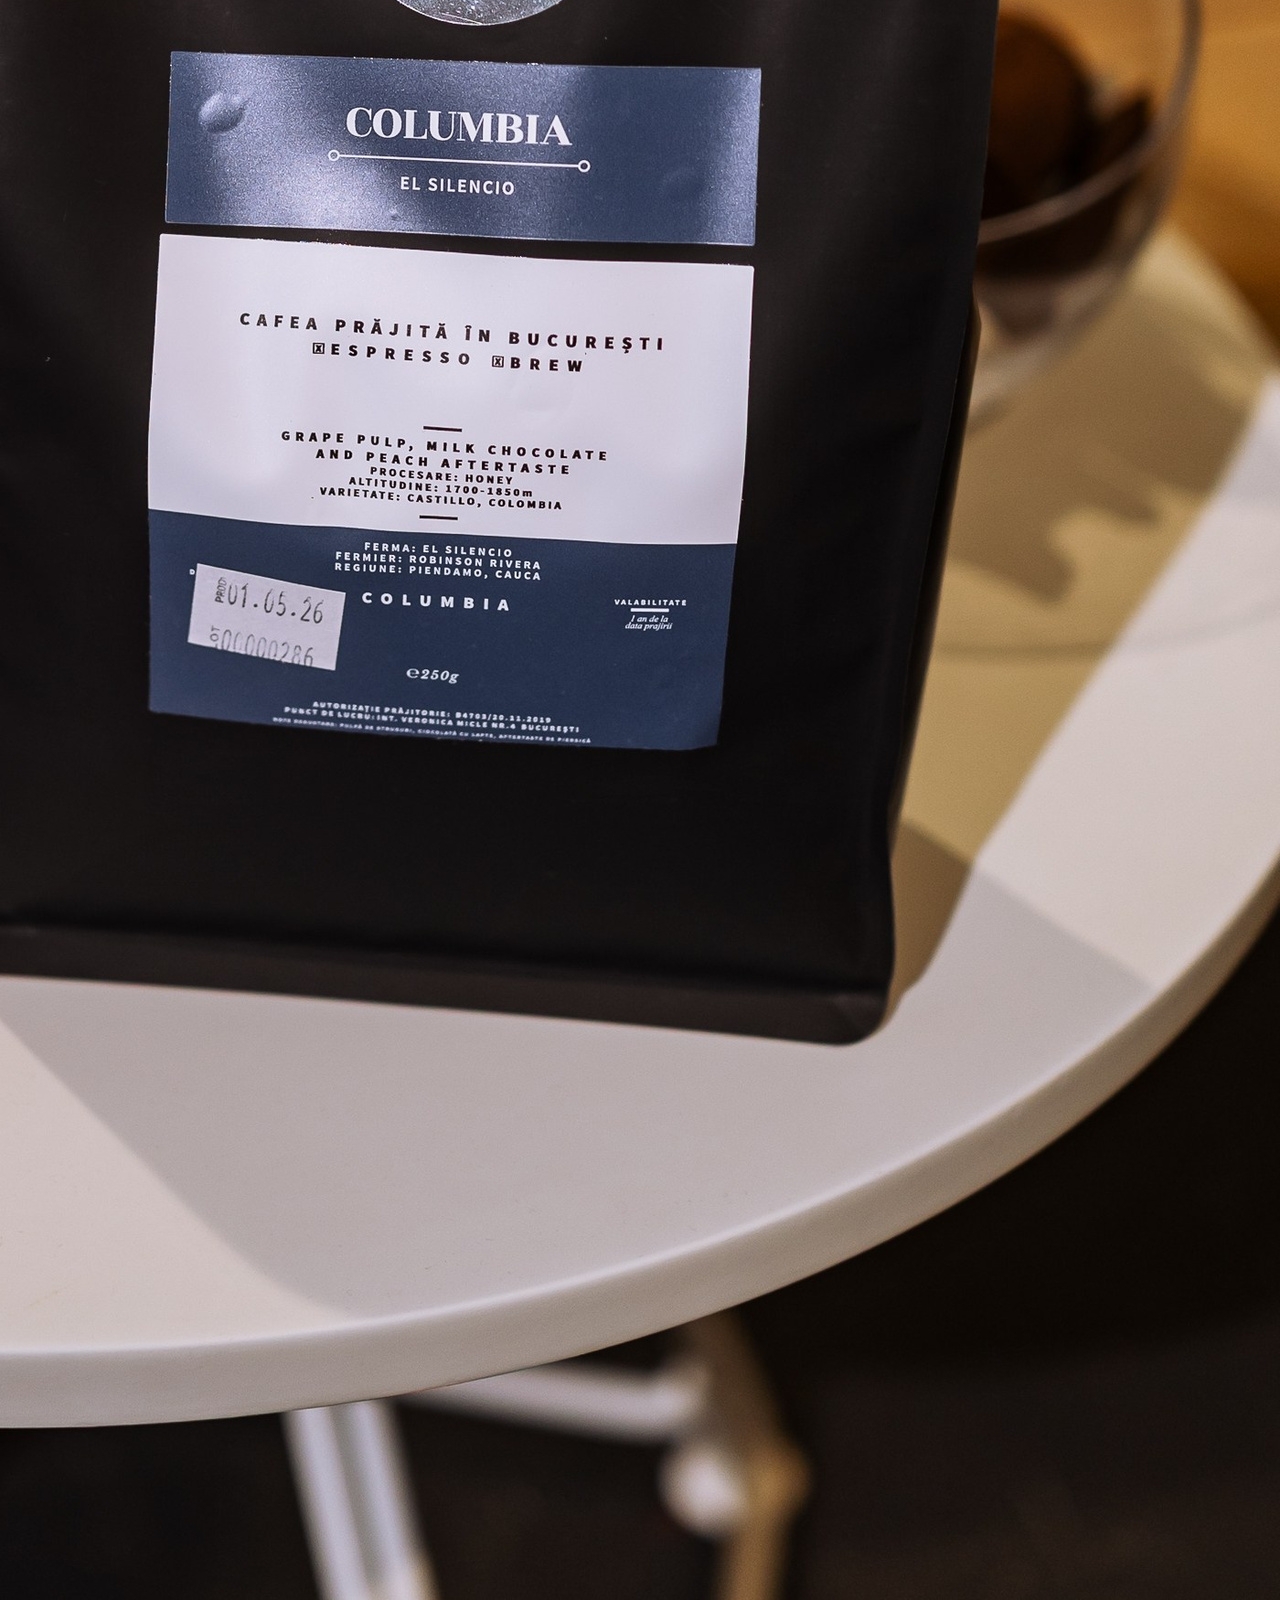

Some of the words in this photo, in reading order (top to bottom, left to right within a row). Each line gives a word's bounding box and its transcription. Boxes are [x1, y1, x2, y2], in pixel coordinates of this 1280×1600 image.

[345, 107, 572, 146] COLUMBIA
[400, 176, 420, 191] EL
[428, 177, 515, 196] SILENCIO
[240, 312, 318, 331] CAFEA
[335, 318, 448, 340] PRĂJITĂ
[465, 325, 491, 343] ÎN
[281, 430, 345, 444] GRAPE
[357, 434, 414, 452] PULP,
[426, 440, 476, 455] MILK
[488, 445, 608, 461] CHOCOLATE
[316, 448, 353, 460] AND
[366, 451, 429, 467] PEACH
[441, 458, 571, 475] AFTERTASTE
[370, 466, 458, 482] PROCESARE:
[465, 473, 513, 485] HONEY
[349, 476, 438, 492] ALTITUDINE:
[445, 484, 533, 497] 1700-1850m
[320, 486, 401, 502] VARIETATE:
[407, 493, 482, 508] CASTILLO,
[488, 498, 562, 510] COLOMBIA
[364, 541, 416, 553] FERMA:
[423, 544, 439, 554] EL
[445, 545, 512, 558] SILENCIO
[335, 551, 403, 563] FERMIER:
[409, 554, 483, 567] ROBINSON
[489, 558, 541, 570] RIVERA
[335, 563, 403, 574] REGIUNE:
[409, 565, 489, 580] PIENDAMO,
[495, 570, 542, 581] CAUCA
[228, 582, 324, 625] 01.05.26
[361, 592, 510, 612] COLUMBIA
[284, 706, 318, 716] PUNCT
[401, 716, 454, 726] VERONICA
[457, 720, 488, 728] MICLE
